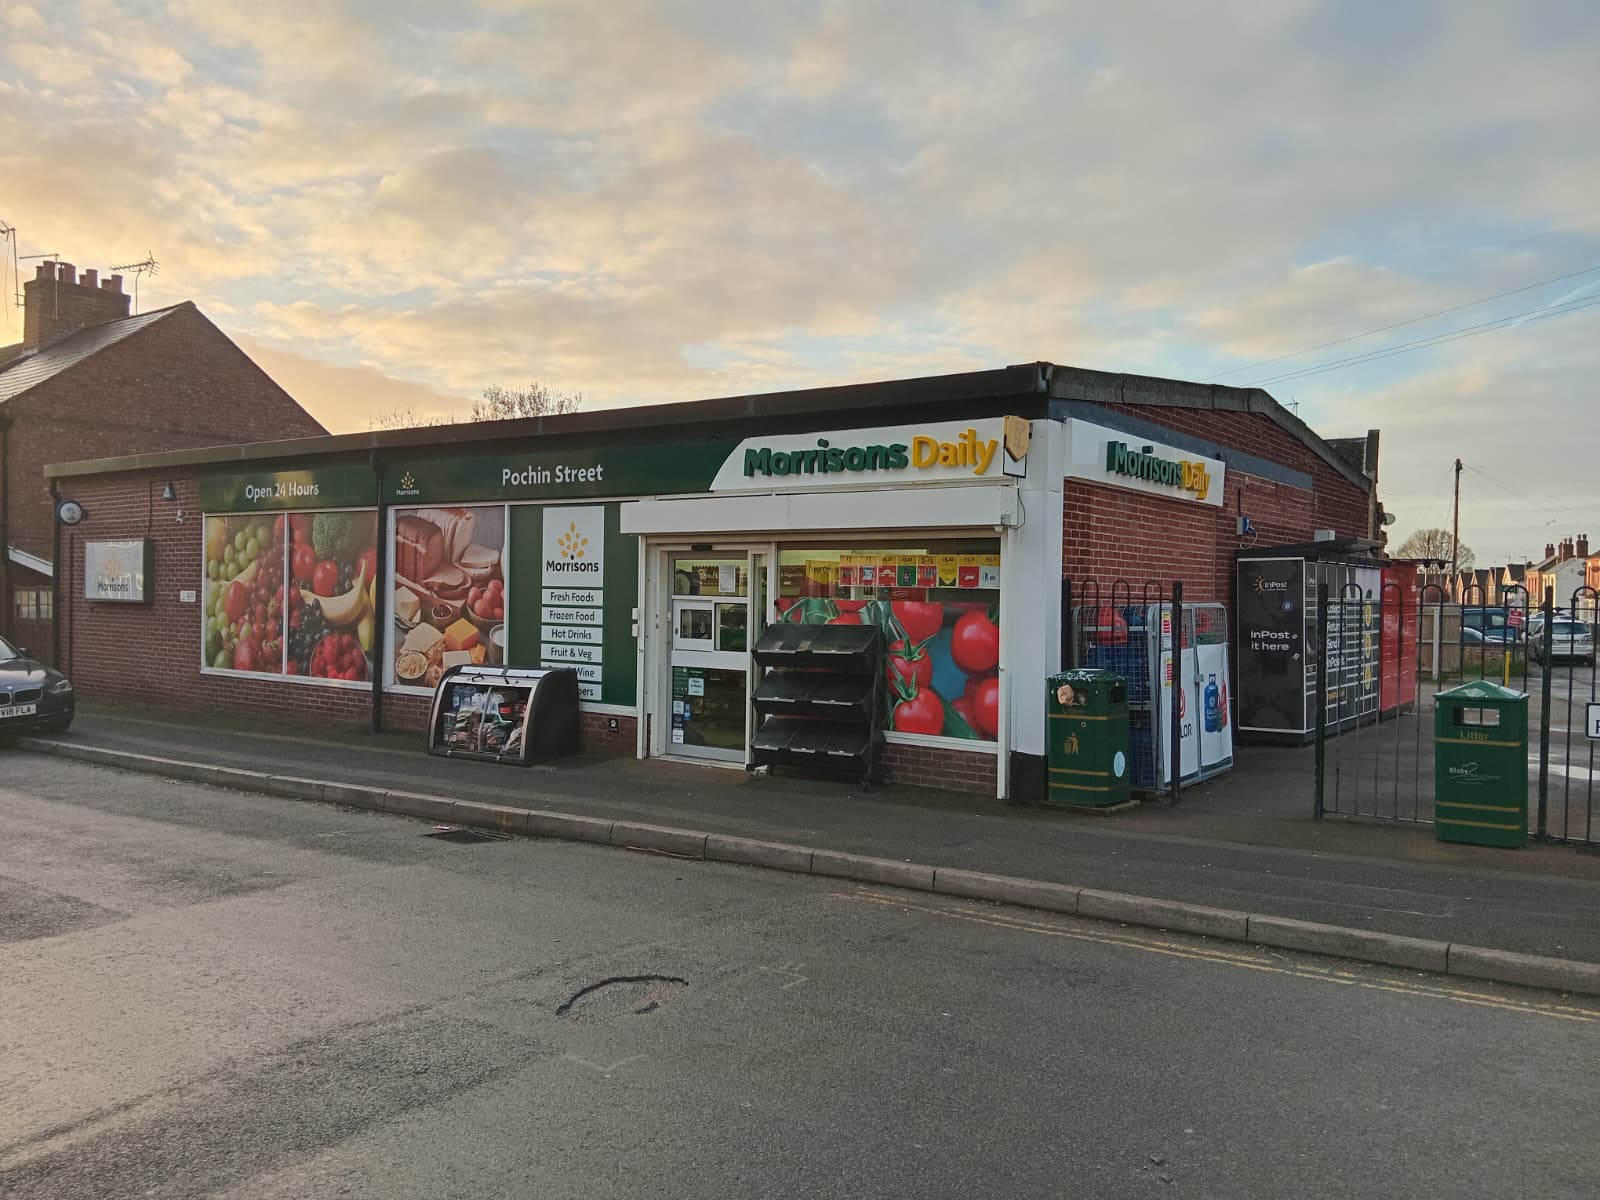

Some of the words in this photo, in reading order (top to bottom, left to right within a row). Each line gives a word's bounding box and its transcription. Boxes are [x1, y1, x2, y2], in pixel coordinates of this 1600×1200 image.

[743, 438, 908, 478] Morrisons
[911, 428, 999, 476] Daily
[502, 465, 551, 486] Pochin
[555, 464, 604, 483] Street
[1107, 441, 1184, 487] Morrisons
[1180, 460, 1211, 499] Daily
[245, 484, 272, 502] Open
[274, 483, 287, 497] 24
[288, 482, 320, 496] Hours
[546, 556, 600, 573] Morrisons
[550, 592, 570, 602] Fresh
[571, 592, 595, 602] Foods
[549, 610, 574, 620] Frozen
[575, 611, 595, 621] Food
[551, 628, 566, 638] Hot
[567, 629, 592, 640] Drinks
[1250, 630, 1290, 639] InPost
[1251, 641, 1260, 650] it
[1262, 641, 1290, 651] here
[550, 647, 568, 657] Fruit
[569, 648, 576, 657] &
[577, 648, 593, 661] Veg
[576, 667, 595, 678] Wine
[1460, 730, 1488, 740] Litter
